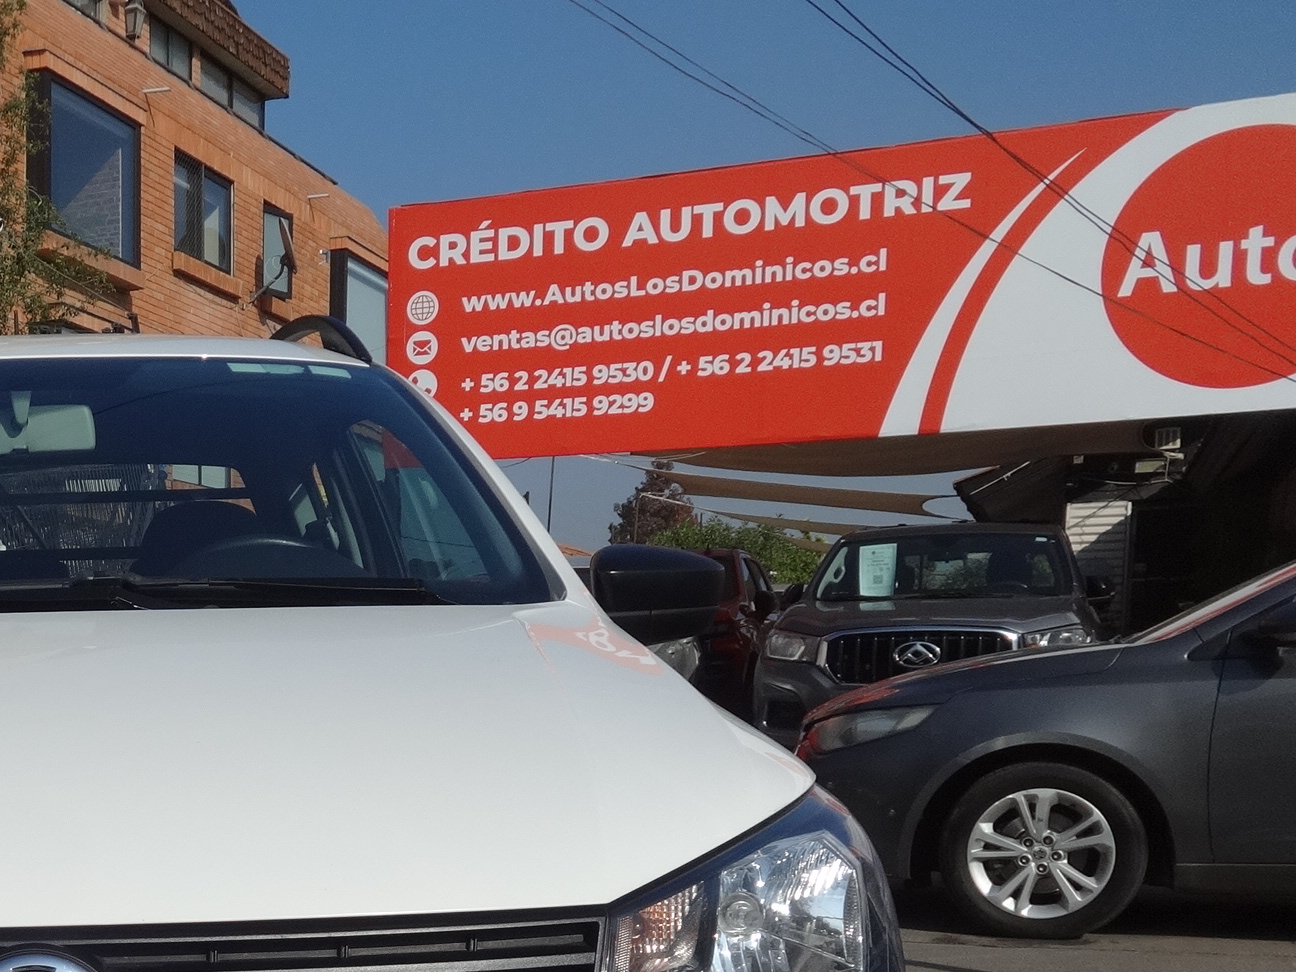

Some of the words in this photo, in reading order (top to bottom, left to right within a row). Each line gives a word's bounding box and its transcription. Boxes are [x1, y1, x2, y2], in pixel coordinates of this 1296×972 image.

[408, 217, 610, 270] CRÉDITO
[621, 172, 972, 248] AUTOMOTRIZ
[461, 247, 888, 313] www.AutosLosDominicos.cl
[460, 292, 886, 353] ventas@autoslosdominicos.cl
[479, 372, 510, 393] 56
[513, 370, 529, 391] 2
[533, 365, 588, 390] 2415
[592, 360, 655, 385] 9530
[696, 354, 731, 377] 56
[734, 352, 752, 374] 2
[756, 346, 817, 372] 2415
[822, 340, 883, 366] 9531
[477, 402, 508, 424] 56
[512, 401, 529, 421] 9
[533, 396, 588, 420] 5415
[592, 391, 655, 416] 9299
